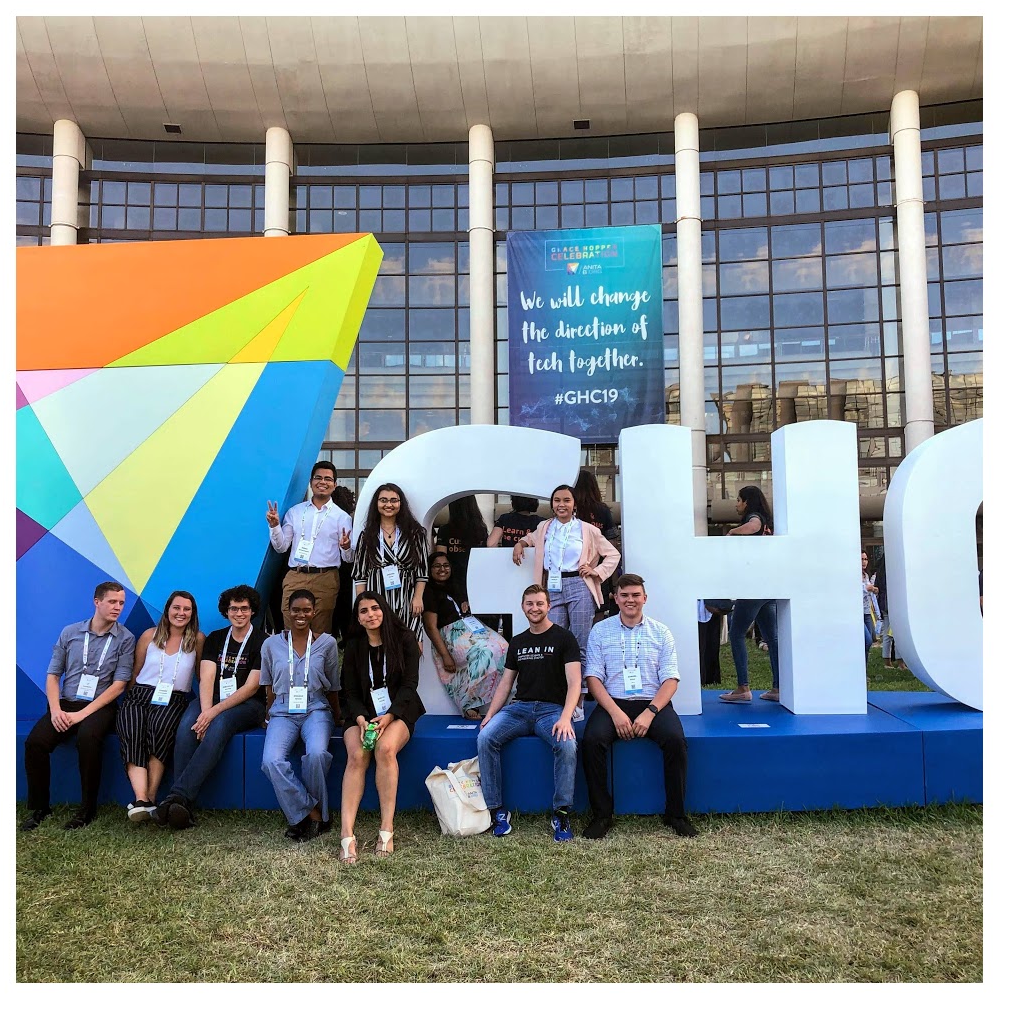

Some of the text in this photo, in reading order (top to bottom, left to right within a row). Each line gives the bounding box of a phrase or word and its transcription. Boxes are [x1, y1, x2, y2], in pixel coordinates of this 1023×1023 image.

[520, 285, 651, 311] We will change
[522, 314, 648, 344] the direction of
[528, 347, 644, 377] tech together.
[555, 388, 619, 405] #GHC19
[503, 526, 524, 536] Learn
[449, 537, 462, 545] Cu
[517, 646, 541, 655] LEAN
